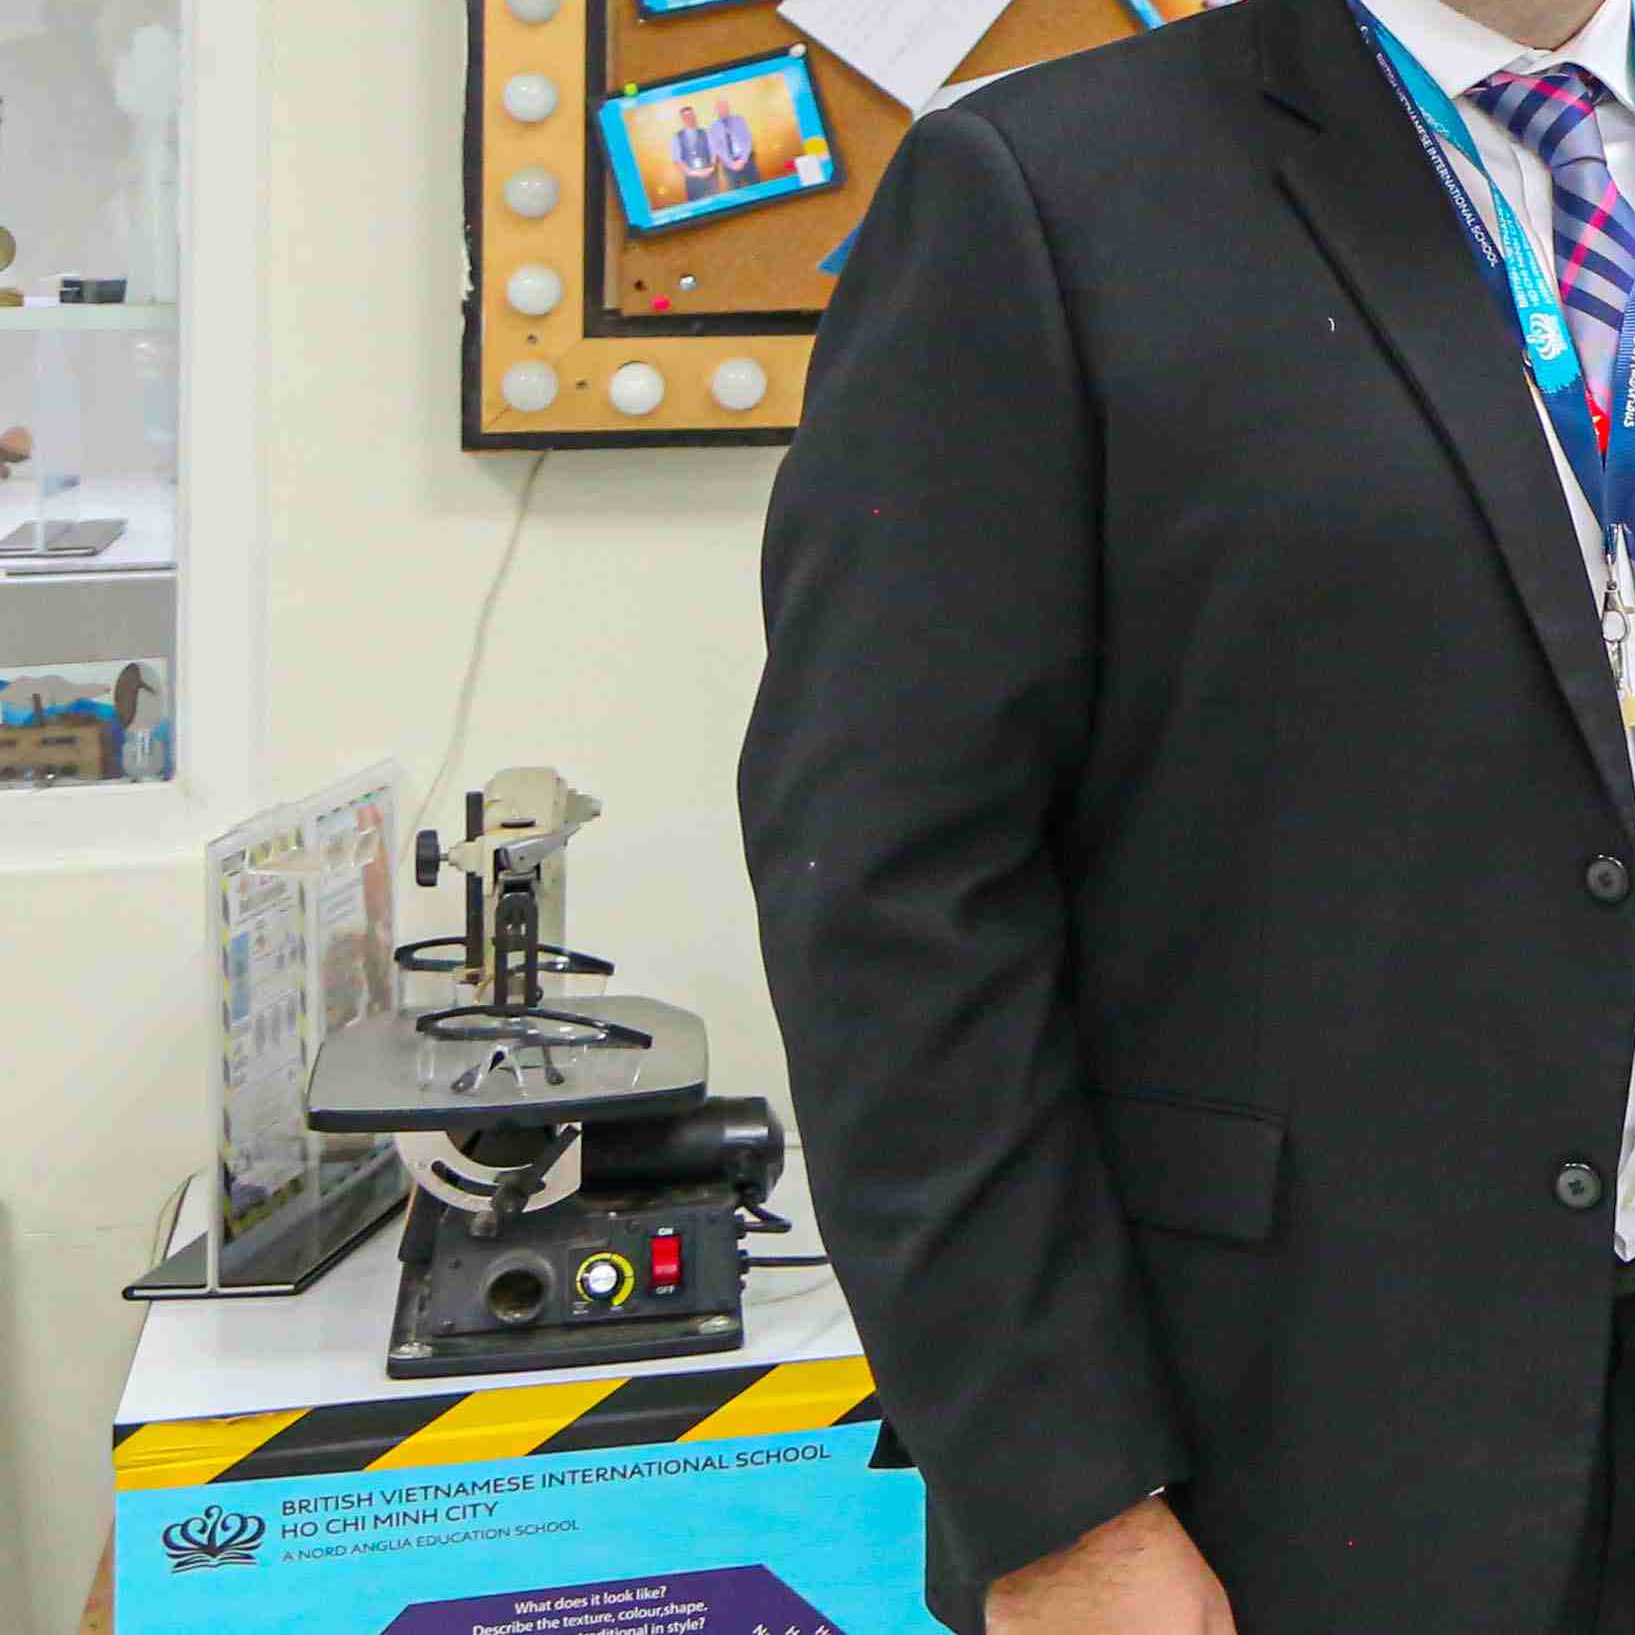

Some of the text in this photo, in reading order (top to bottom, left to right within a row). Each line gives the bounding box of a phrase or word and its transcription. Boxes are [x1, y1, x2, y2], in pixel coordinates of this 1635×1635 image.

[1427, 143, 1473, 225] INTERNATIONAL
[1471, 224, 1499, 267] SCHOOL
[655, 1286, 675, 1295] OFF
[281, 1443, 831, 1517] BRITISH VIETNAMESE INTERNATIONAL SCHOOL
[281, 1501, 499, 1539] HO CHI MINH CITY
[281, 1519, 579, 1562] A NORD ANGLIA EDUCATION SCHOOL
[514, 1585, 667, 1615] What does it look like?
[472, 1621, 534, 1635] Describe
[536, 1617, 560, 1630] the
[562, 1612, 615, 1628] texture,
[650, 1623, 664, 1635] in
[667, 1617, 706, 1634] style?
